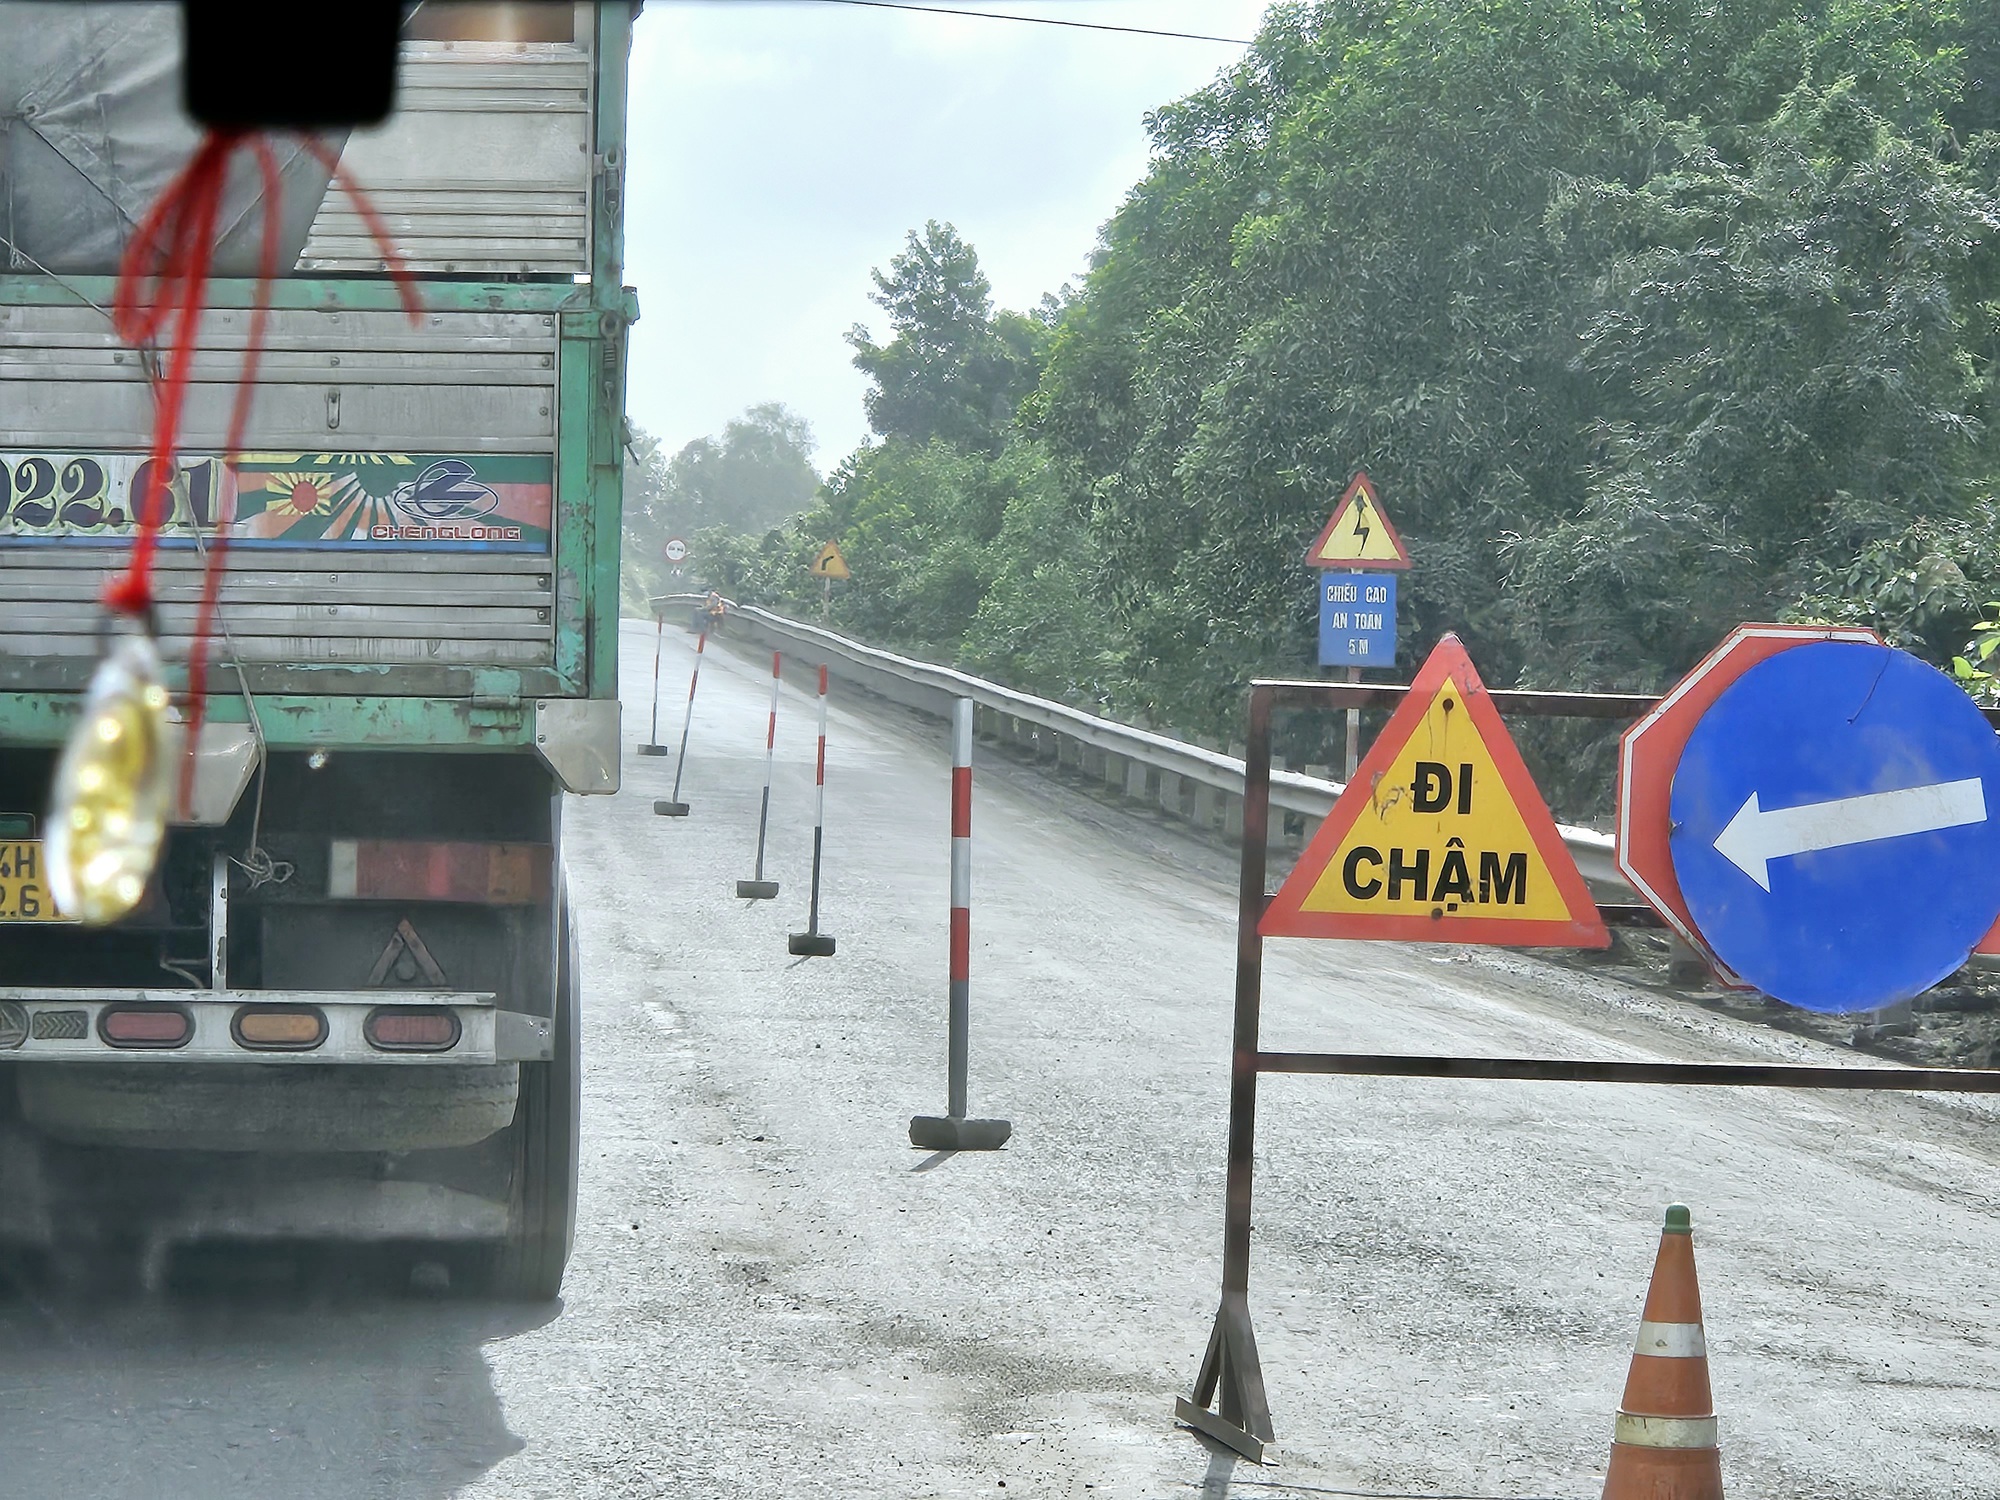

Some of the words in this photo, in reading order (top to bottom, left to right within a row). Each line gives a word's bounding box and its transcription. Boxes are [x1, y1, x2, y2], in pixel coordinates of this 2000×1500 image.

[0, 457, 219, 530] 22.61
[371, 525, 522, 541] CHENGLONG
[1365, 586, 1387, 603] CAO
[1332, 612, 1348, 629] AN
[1410, 761, 1474, 815] ĐI
[1342, 837, 1528, 912] CHẬM
